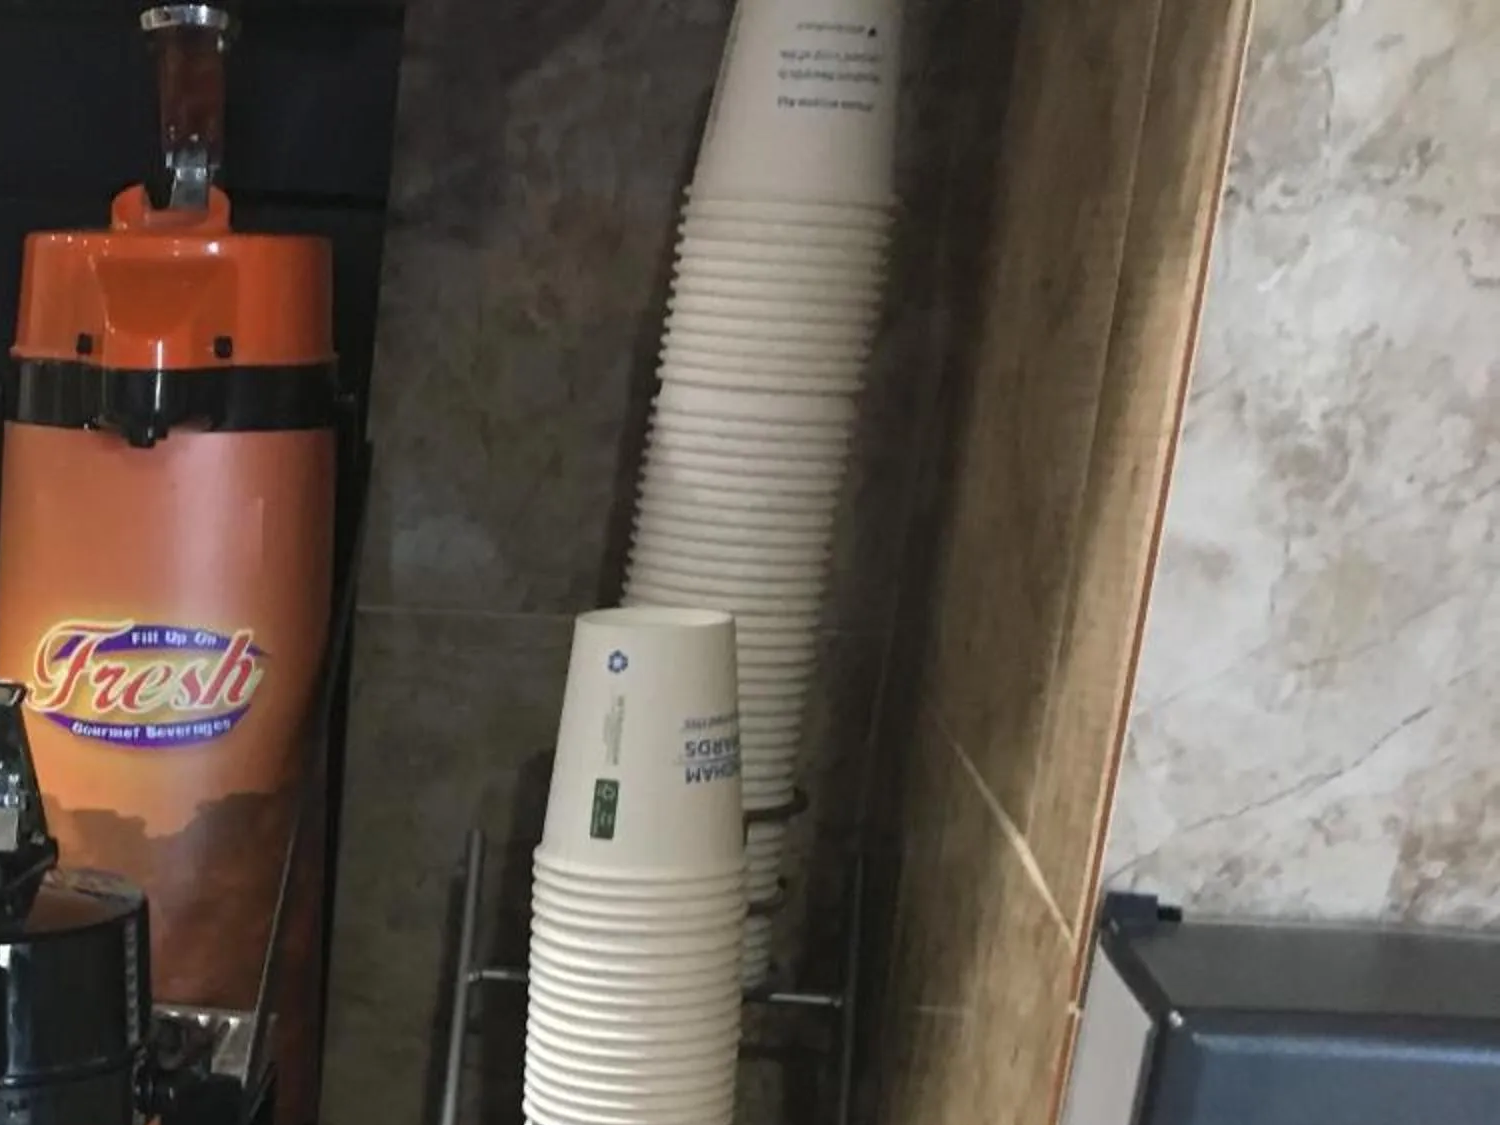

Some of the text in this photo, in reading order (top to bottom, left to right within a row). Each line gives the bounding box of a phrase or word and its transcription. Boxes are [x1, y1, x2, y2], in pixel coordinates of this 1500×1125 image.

[131, 629, 217, 646] Fill Up On
[25, 618, 265, 713] Fresh
[71, 718, 232, 740] Gourmet Beverages
